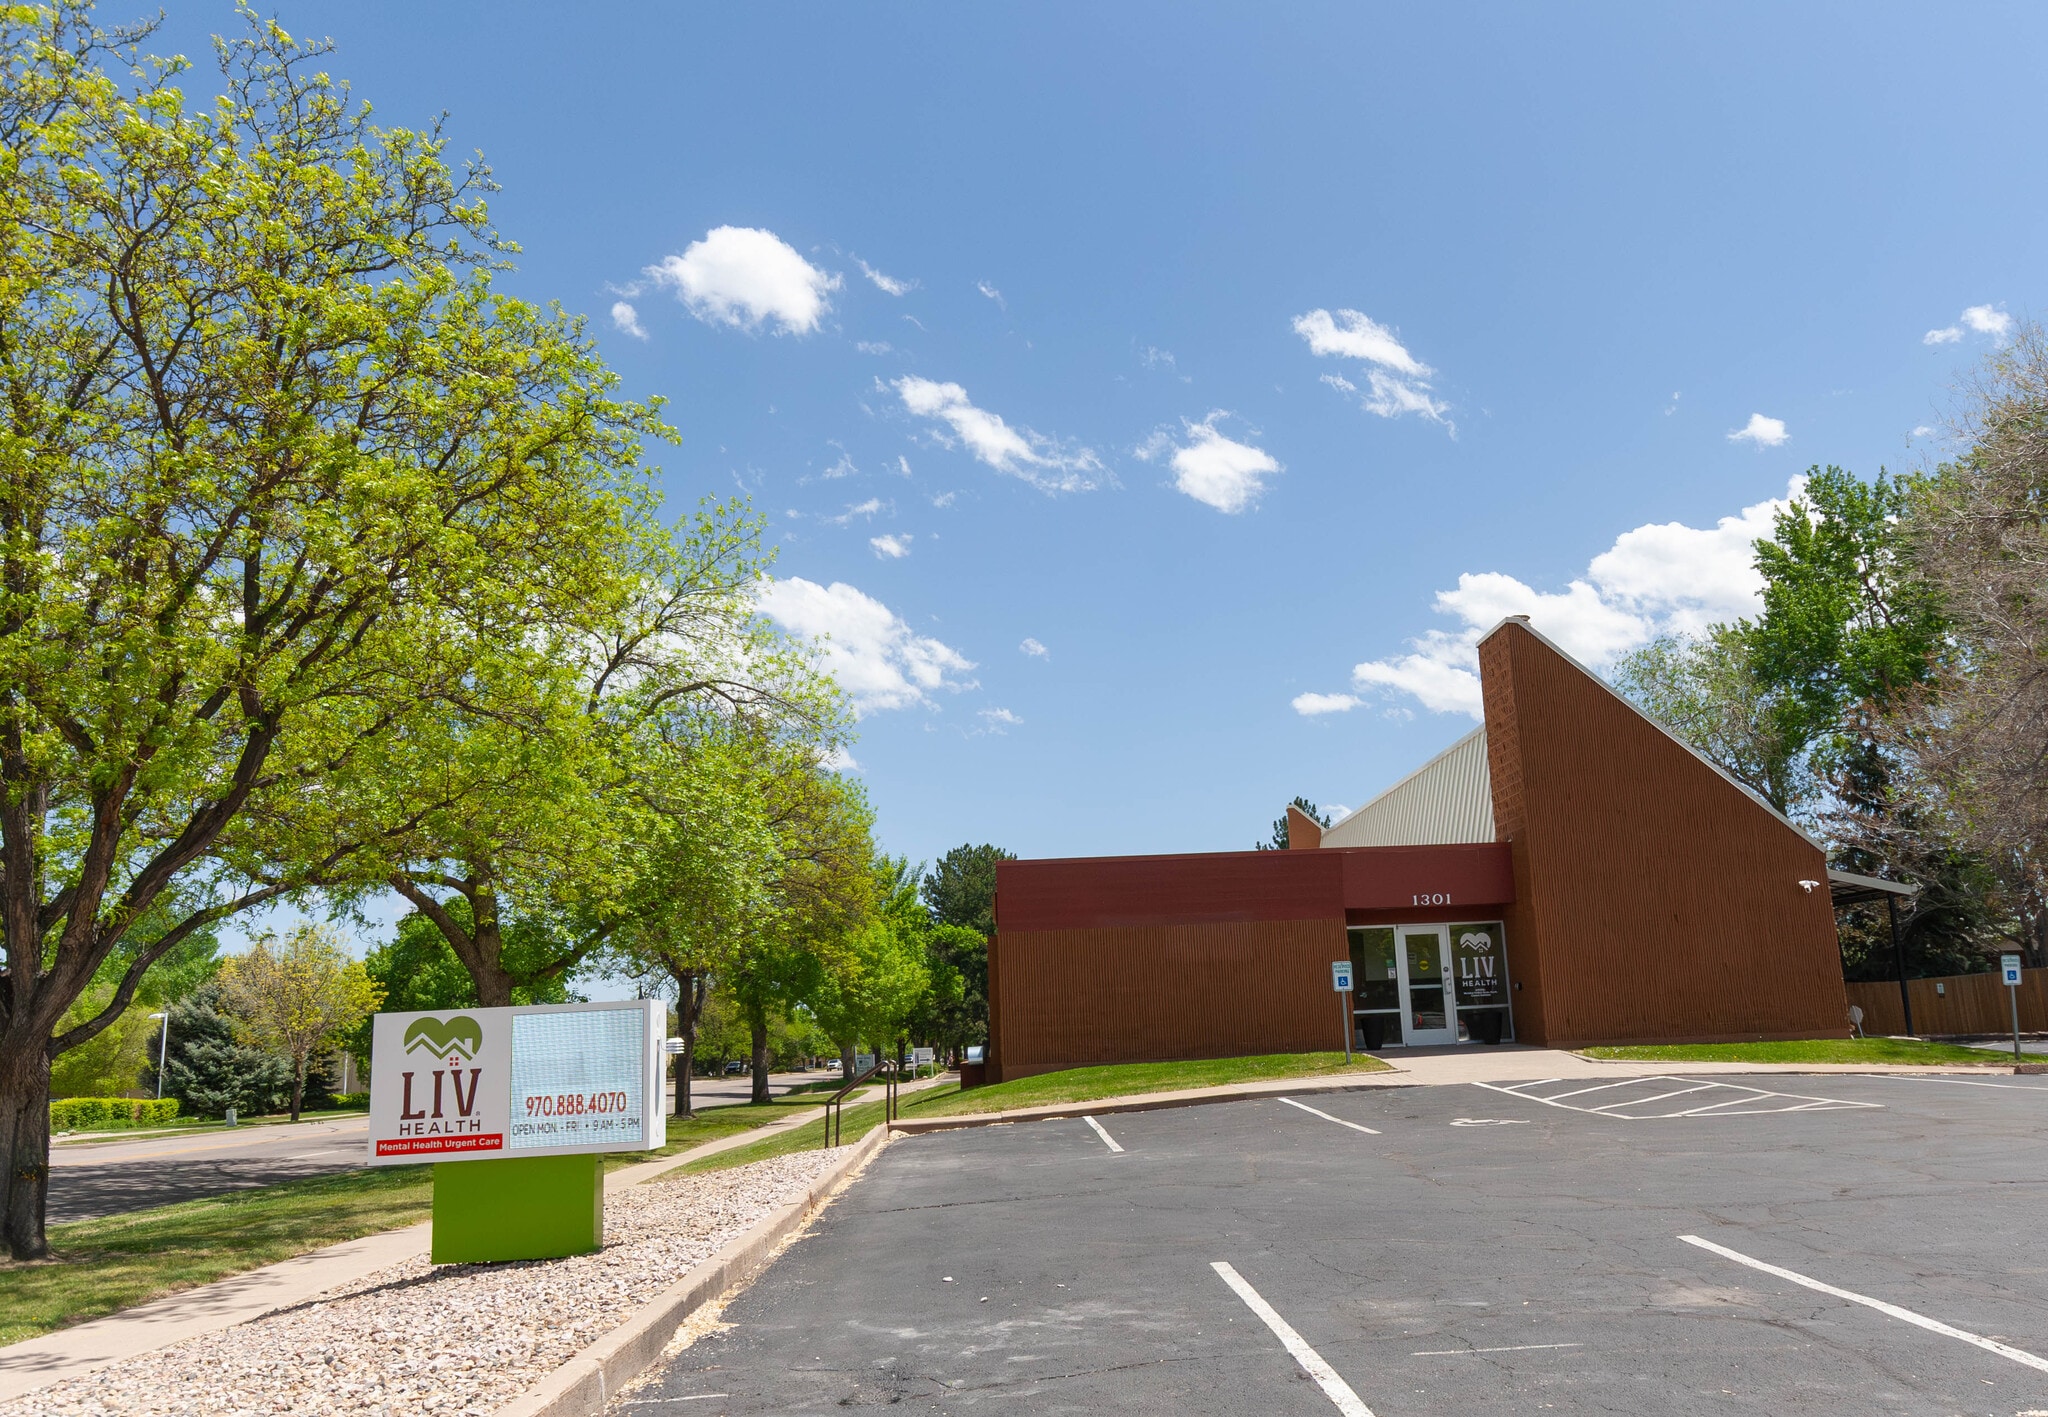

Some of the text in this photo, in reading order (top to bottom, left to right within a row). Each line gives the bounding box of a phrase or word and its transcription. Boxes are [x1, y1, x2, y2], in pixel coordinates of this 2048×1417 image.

[1413, 893, 1451, 905] 1301
[1460, 956, 1495, 979] LIV
[1462, 979, 1498, 987] HEALTH
[400, 1068, 482, 1120] LIV
[526, 1091, 627, 1117] 970.888.4070
[399, 1119, 481, 1136] HEALTH
[512, 1122, 535, 1136] OPEN
[593, 1119, 598, 1131] 9
[600, 1119, 614, 1130] AM
[628, 1117, 640, 1128] PM
[379, 1136, 500, 1152] Mental Health Urgent Care
